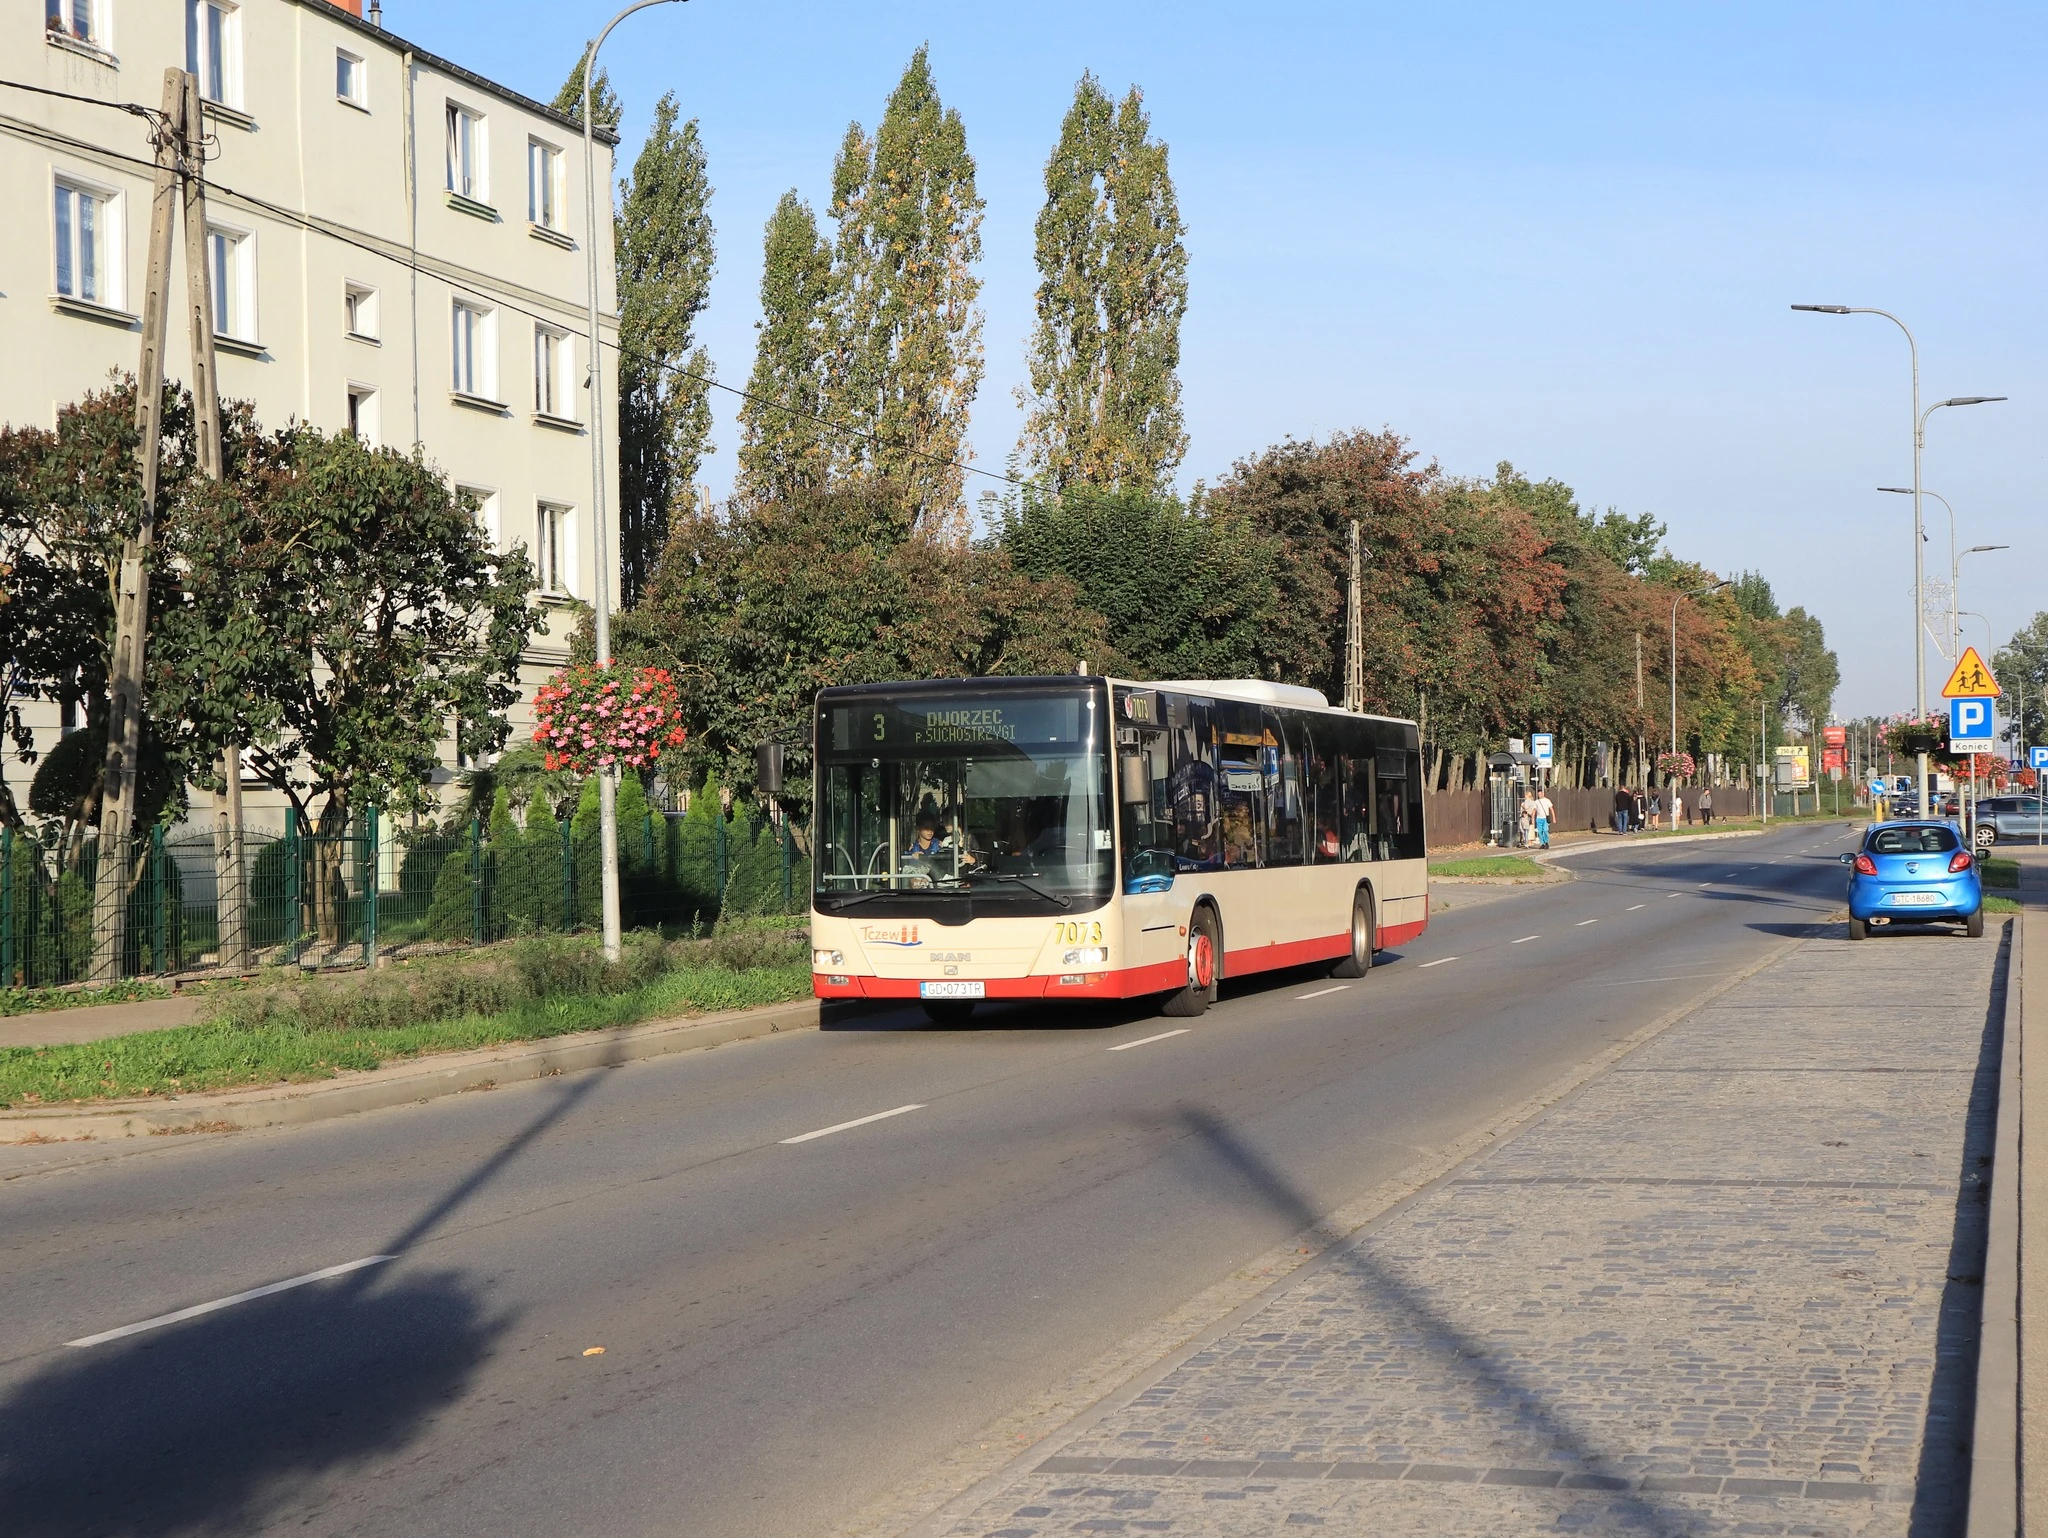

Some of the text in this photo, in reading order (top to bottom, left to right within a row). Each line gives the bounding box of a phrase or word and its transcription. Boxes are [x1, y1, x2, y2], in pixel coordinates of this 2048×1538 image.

[926, 709, 1003, 727] DWORZEC
[1959, 702, 1984, 735] P
[873, 713, 885, 741] 3
[1955, 742, 1988, 751] Koniec
[859, 925, 900, 941] Tczew
[1055, 921, 1102, 945] 7073
[930, 952, 972, 962] MAN
[928, 983, 982, 995] GD 073TR
